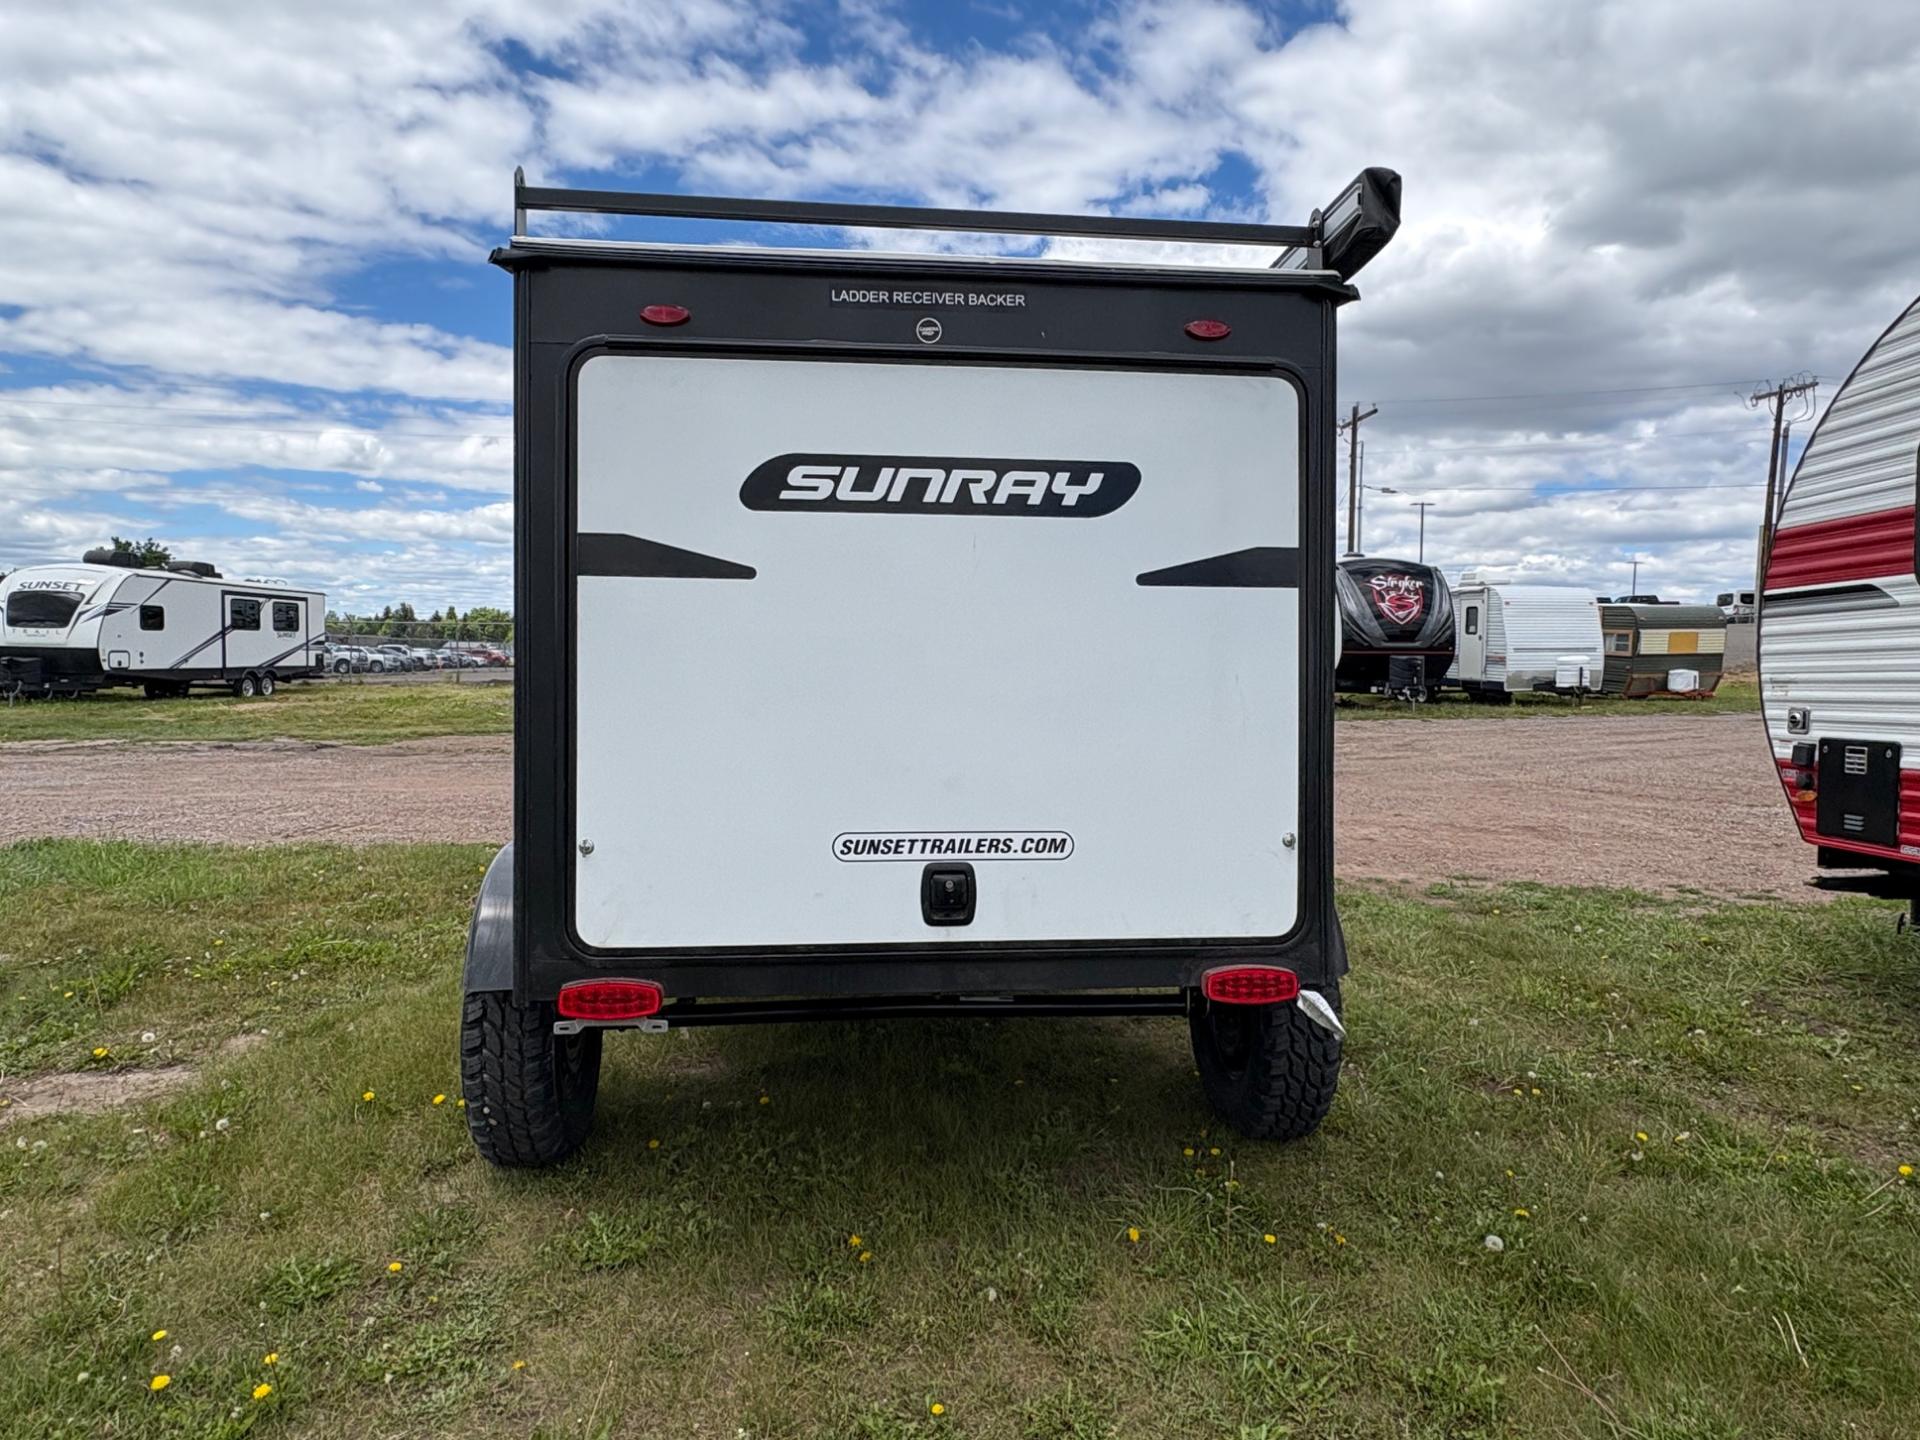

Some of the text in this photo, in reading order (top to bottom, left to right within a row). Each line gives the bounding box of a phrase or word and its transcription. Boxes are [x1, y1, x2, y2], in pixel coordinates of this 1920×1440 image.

[831, 289, 1026, 307] LADDER RECEIVER BACKER
[778, 464, 1104, 506] SUNRAY
[18, 581, 83, 591] SUNSET
[839, 838, 1066, 856] SUNSETTRAILERS.COM
